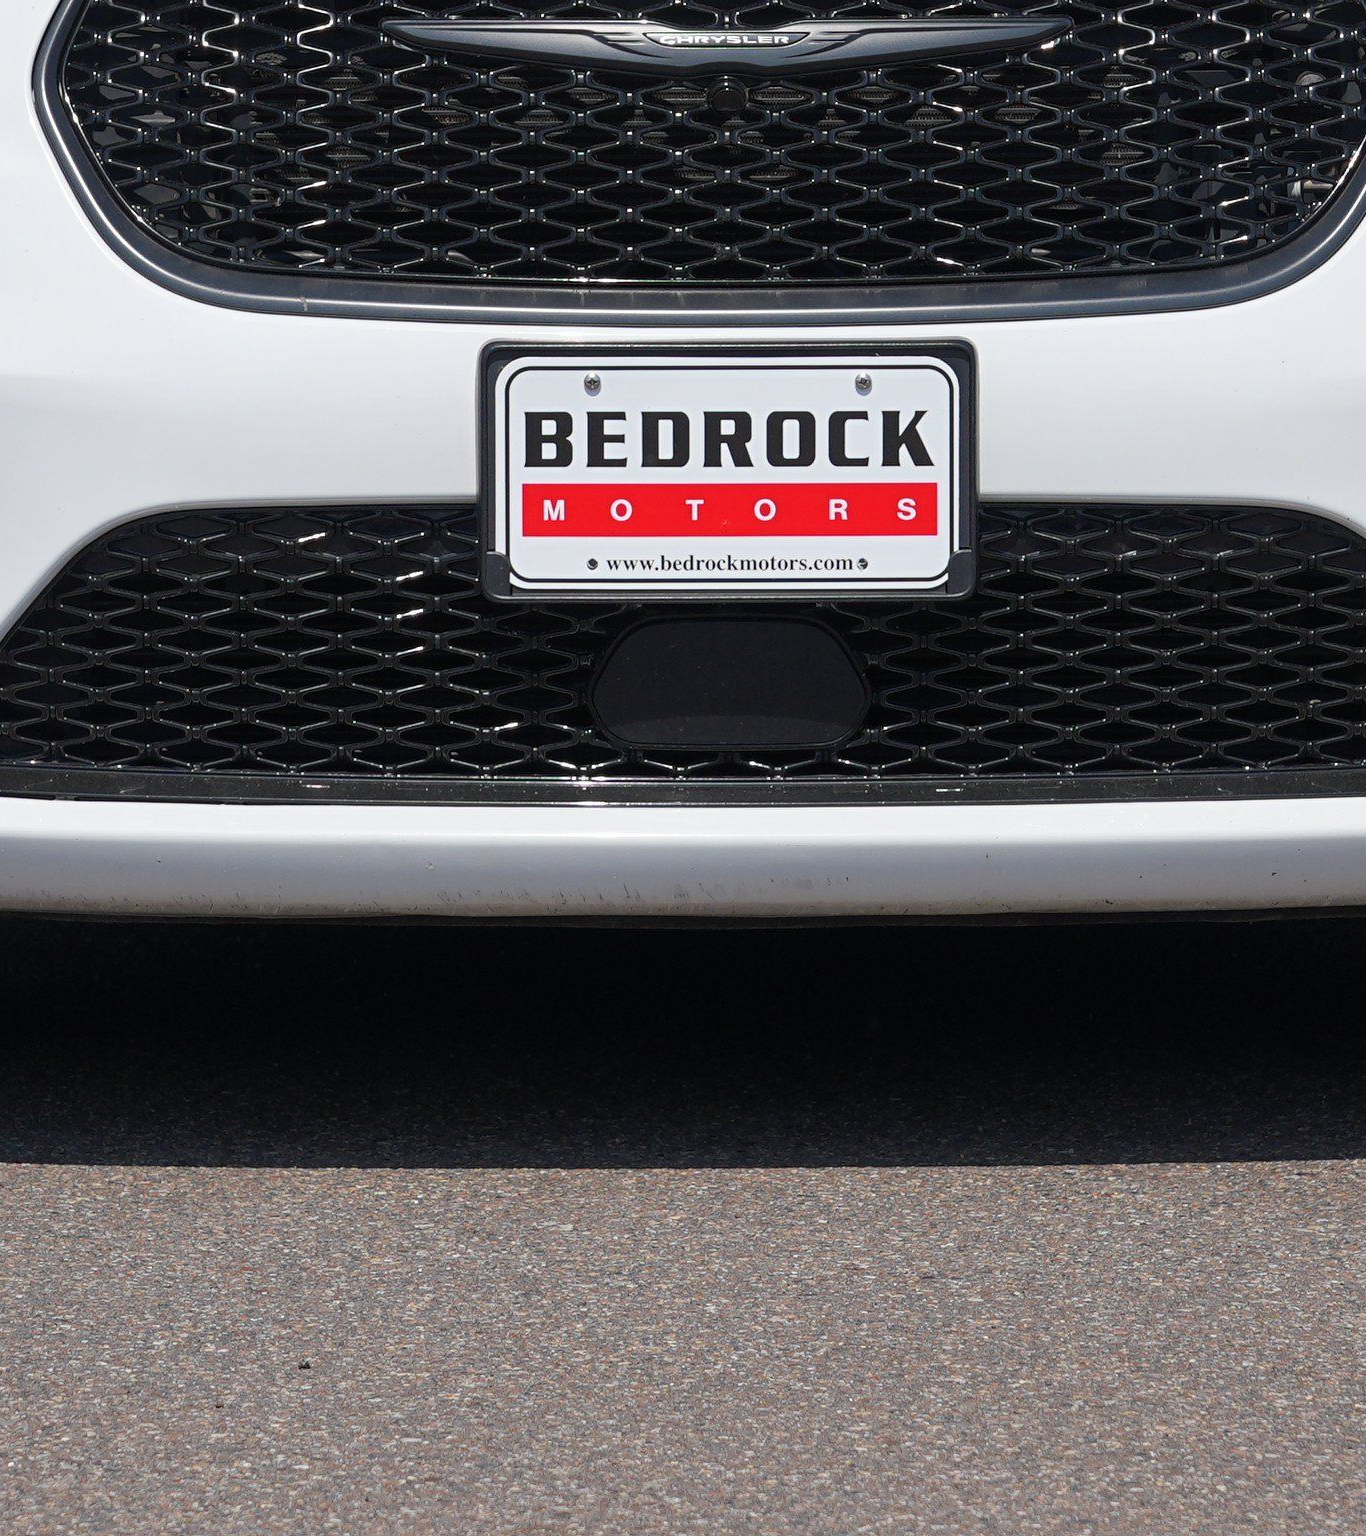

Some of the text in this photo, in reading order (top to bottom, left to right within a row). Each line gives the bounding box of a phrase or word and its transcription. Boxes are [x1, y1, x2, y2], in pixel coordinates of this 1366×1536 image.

[659, 35, 789, 45] CHRYSLER
[524, 411, 935, 467] BEDROCK
[542, 498, 917, 521] MOTORS
[606, 554, 854, 572] www.bedrockmotors.com
